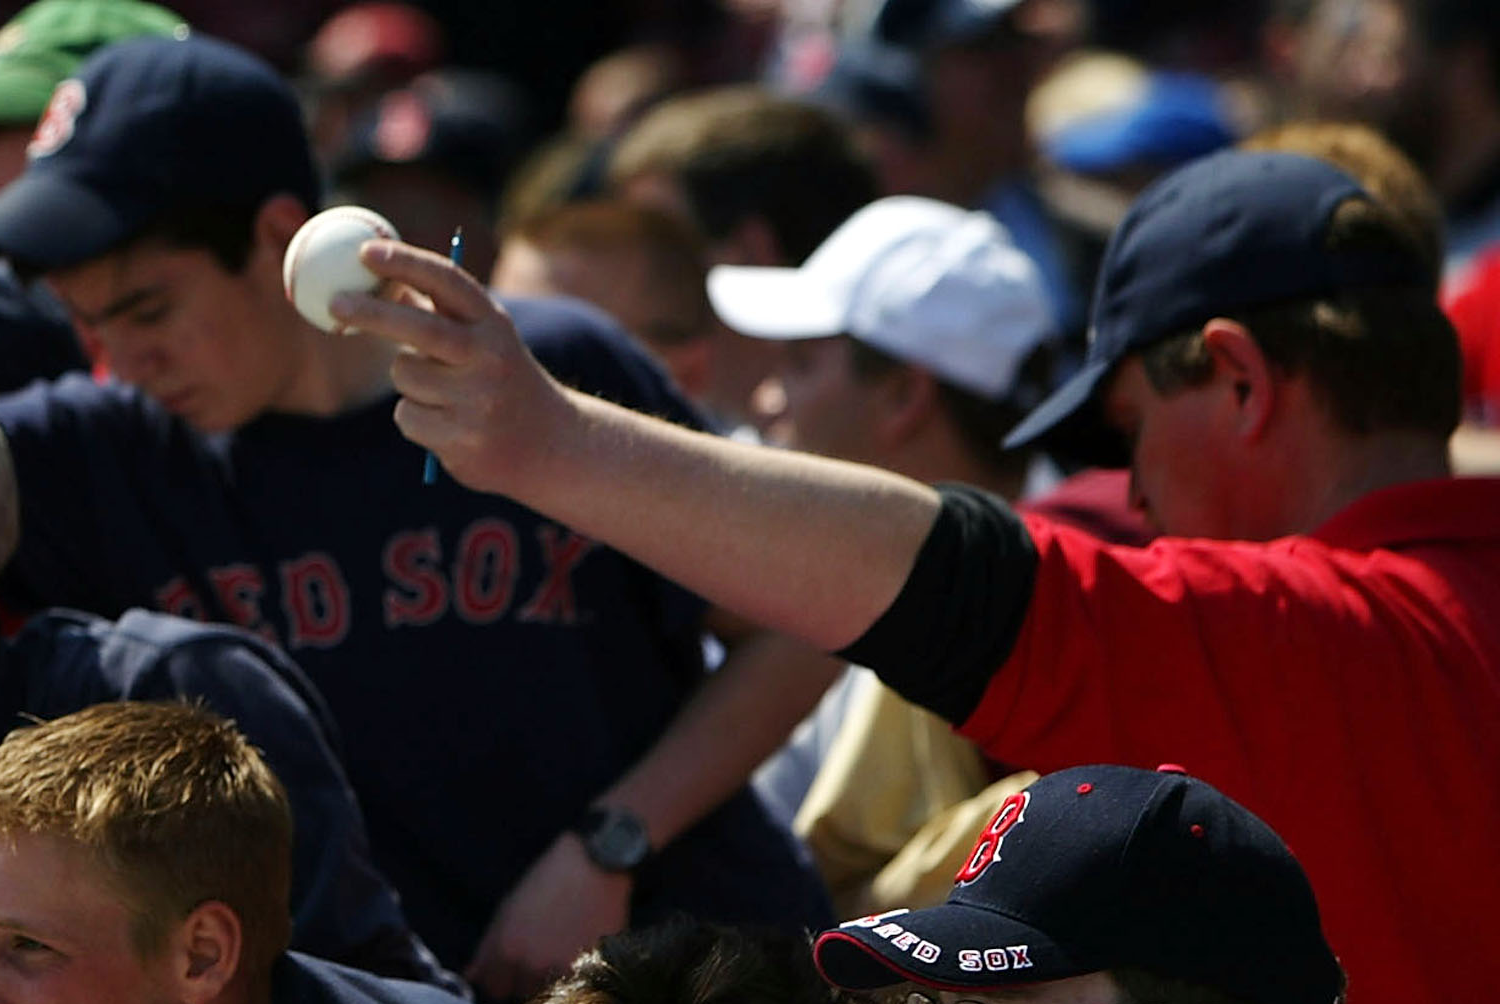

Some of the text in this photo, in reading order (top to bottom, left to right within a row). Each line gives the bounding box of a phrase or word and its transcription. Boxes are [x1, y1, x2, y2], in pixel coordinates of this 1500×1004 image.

[383, 517, 593, 628] SOX
[954, 791, 1031, 888] B
[872, 923, 1034, 972] RED SOX
